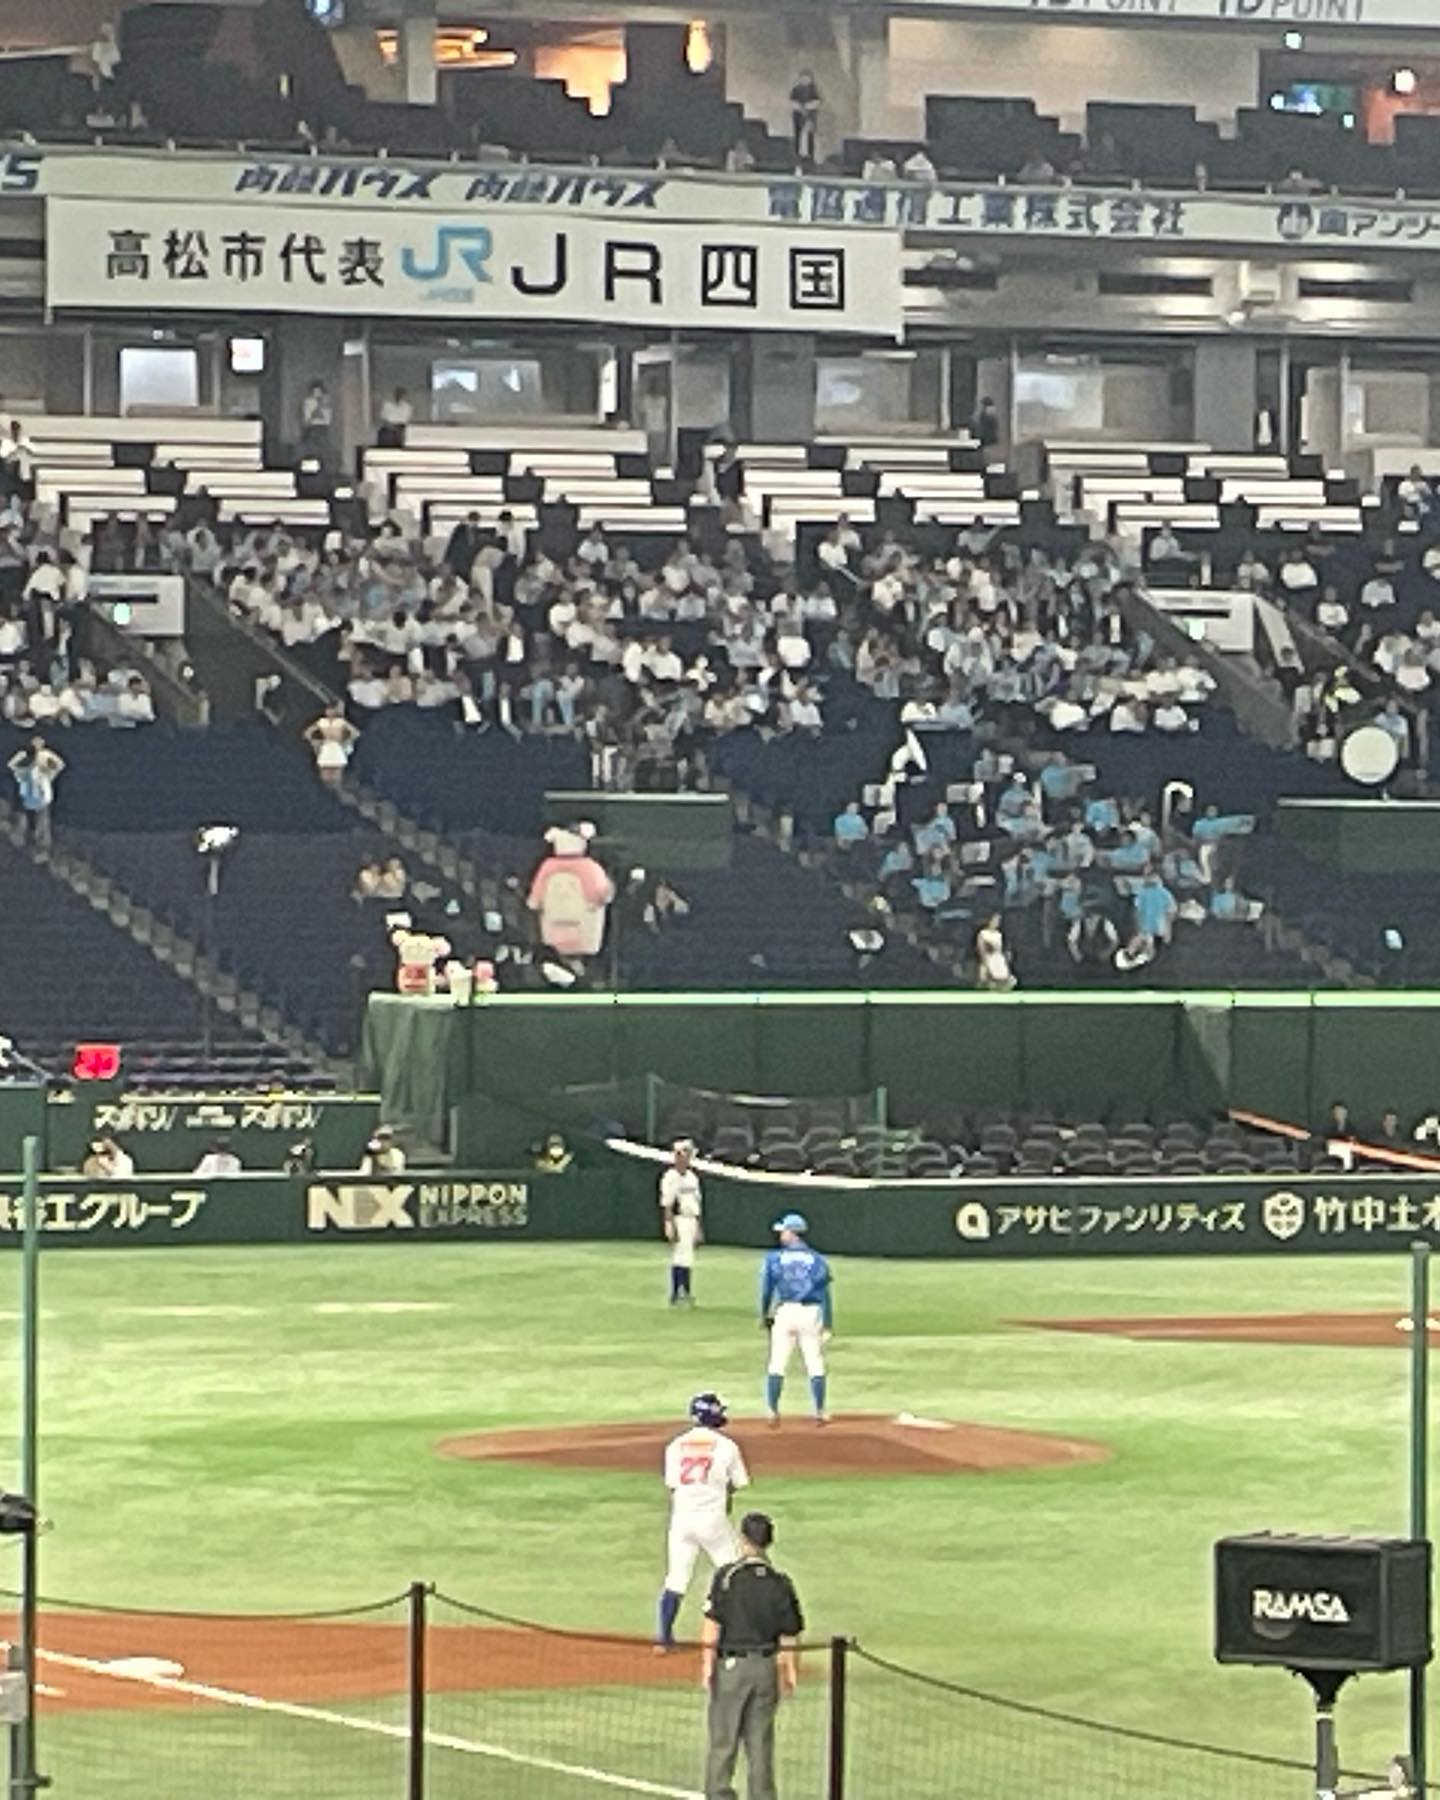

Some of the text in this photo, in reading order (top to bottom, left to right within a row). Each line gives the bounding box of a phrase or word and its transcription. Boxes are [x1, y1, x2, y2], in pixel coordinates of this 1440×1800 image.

[106, 226, 845, 310] 高松市代表 JR JR四国
[420, 1184, 527, 1204] NIPPON
[0, 1191, 206, 1231] 谷工グループ
[680, 1456, 712, 1485] 27
[1252, 1589, 1350, 1622] RAMSA
